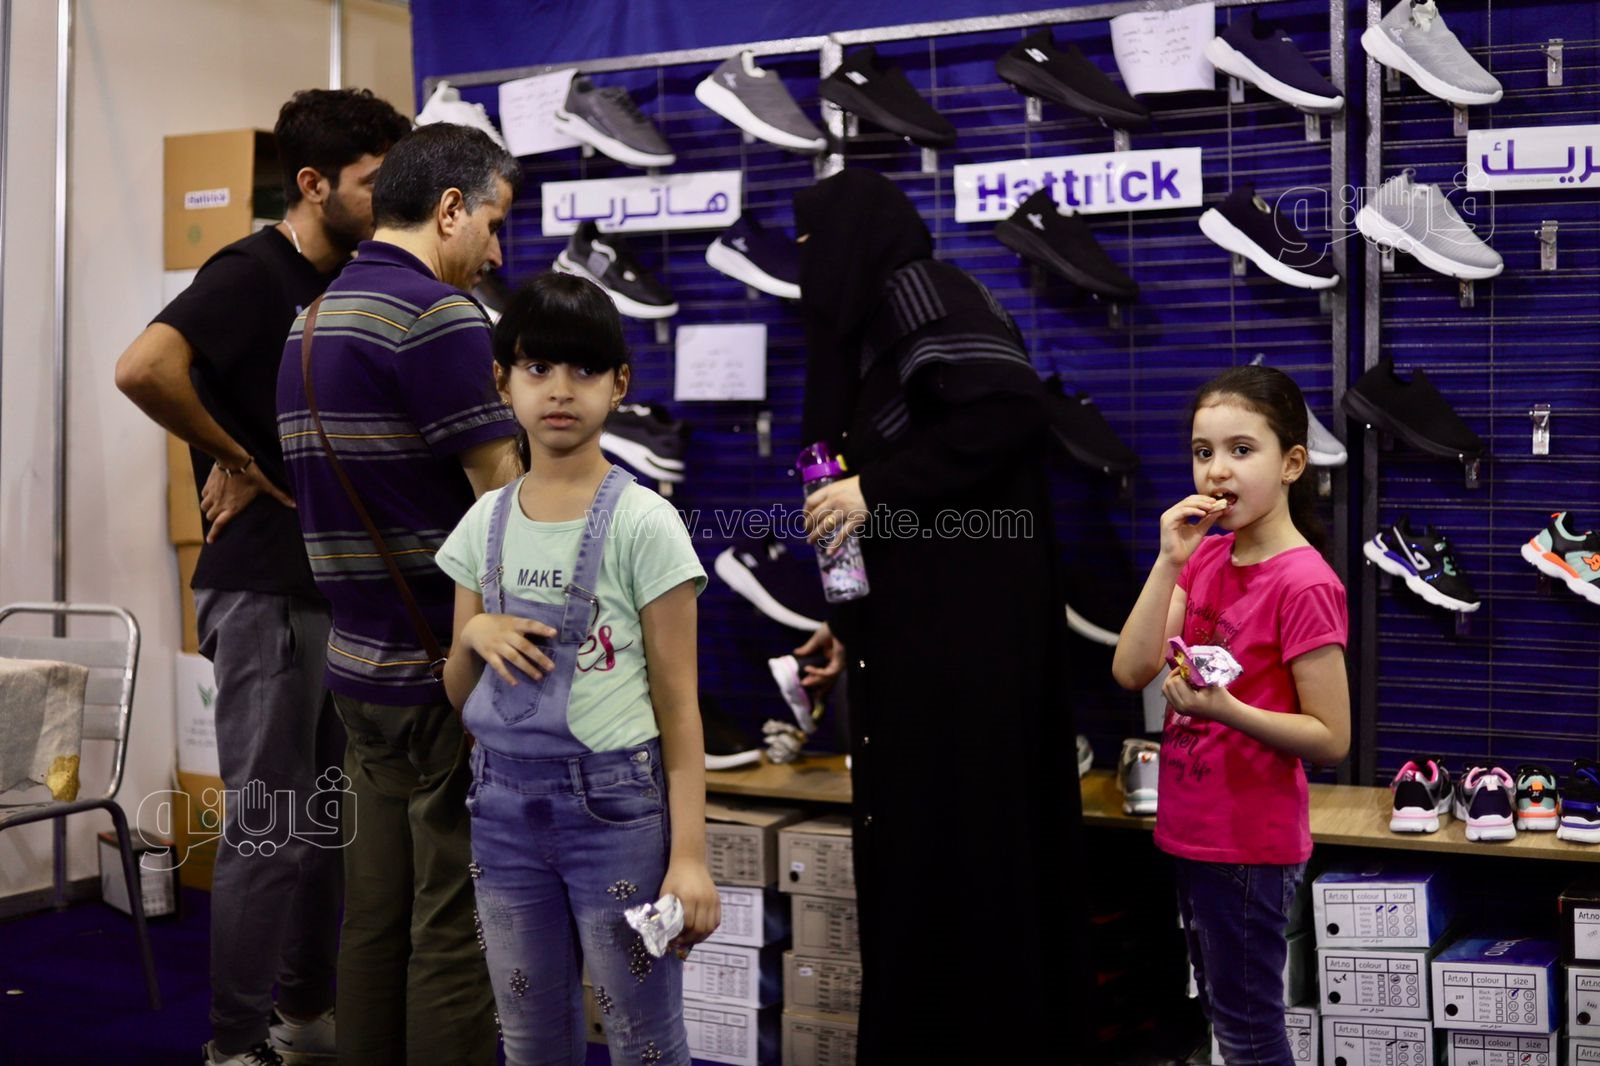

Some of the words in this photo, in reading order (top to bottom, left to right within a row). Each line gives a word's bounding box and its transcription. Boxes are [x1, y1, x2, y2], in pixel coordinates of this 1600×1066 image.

[976, 160, 1182, 212] Hattrick
[517, 568, 563, 588] MAKE
[1395, 962, 1411, 970] size
[1447, 975, 1468, 983] Art.no
[1367, 1028, 1390, 1036] colour
[1488, 1039, 1512, 1047] colour
[1526, 1041, 1542, 1049] size
